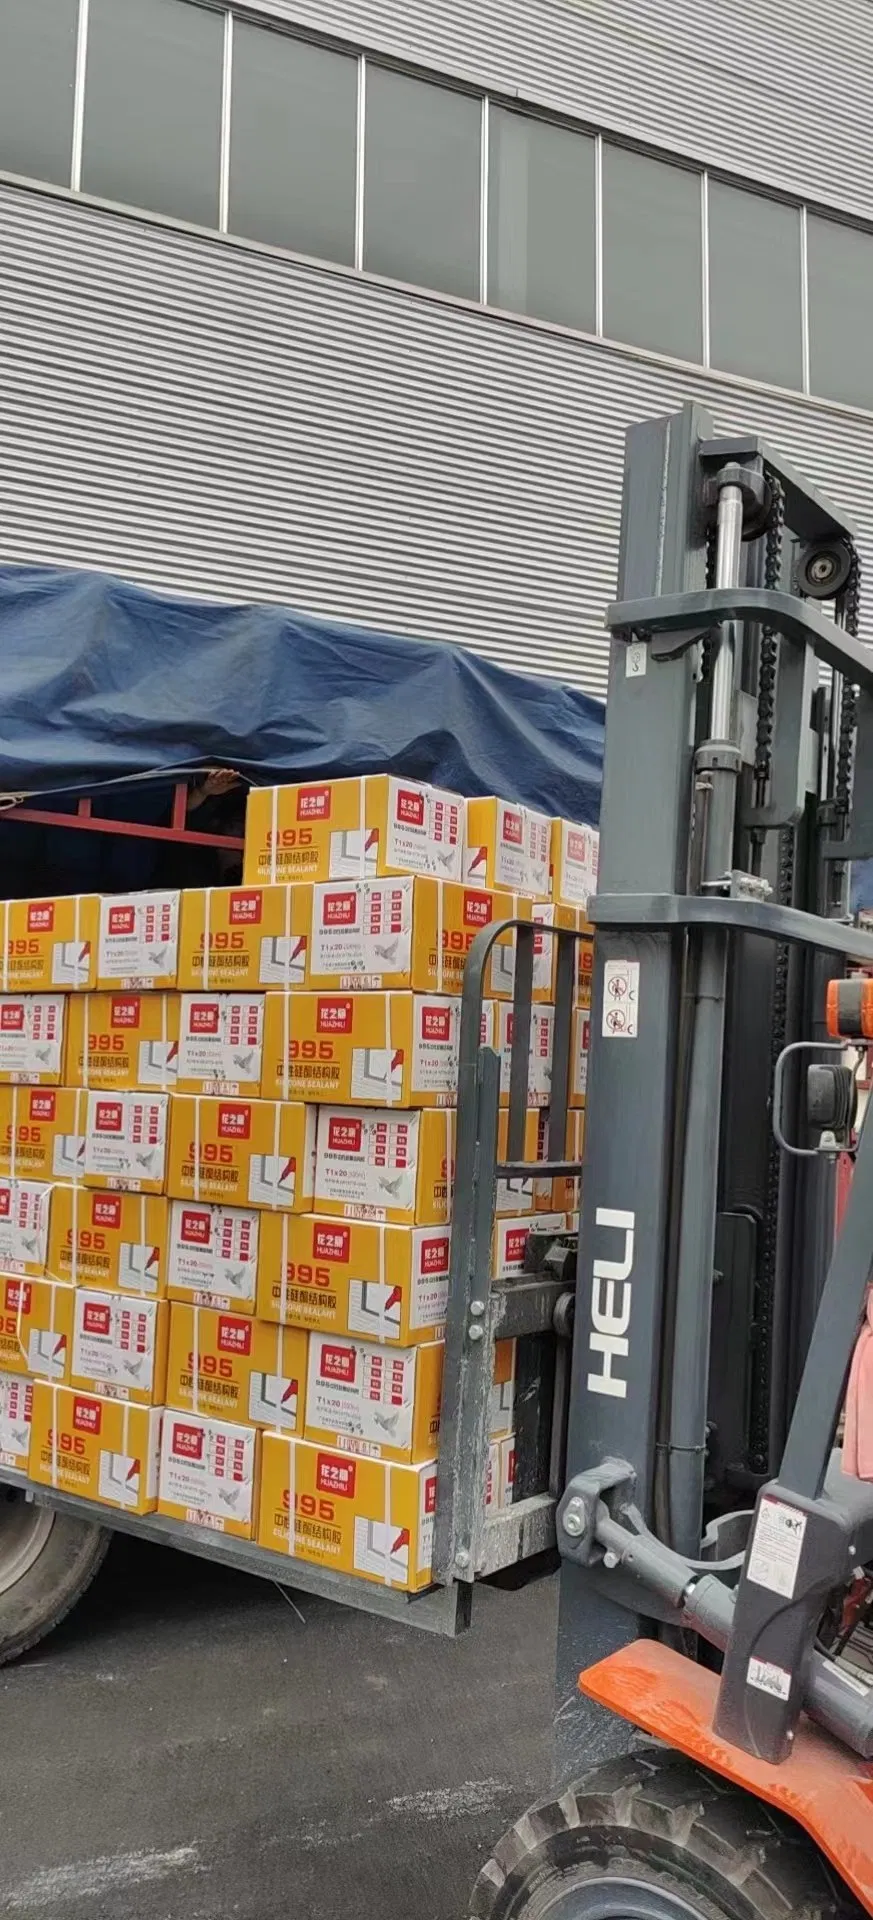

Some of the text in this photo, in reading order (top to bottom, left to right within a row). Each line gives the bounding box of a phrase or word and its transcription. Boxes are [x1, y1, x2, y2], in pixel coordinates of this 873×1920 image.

[266, 828, 313, 848] 995
[200, 931, 244, 949] 995
[320, 1020, 346, 1029] HUAZHILI
[288, 1040, 334, 1059] 995
[6, 1125, 41, 1142] 995
[189, 1141, 233, 1163] 995
[67, 1228, 105, 1250] 995
[316, 1246, 343, 1257] HUAZHILI
[587, 1207, 635, 1398] HELI
[188, 1351, 233, 1377] 995
[48, 1428, 87, 1455] 995
[320, 1478, 348, 1492] HUAZHILI
[283, 1489, 335, 1521] 995
